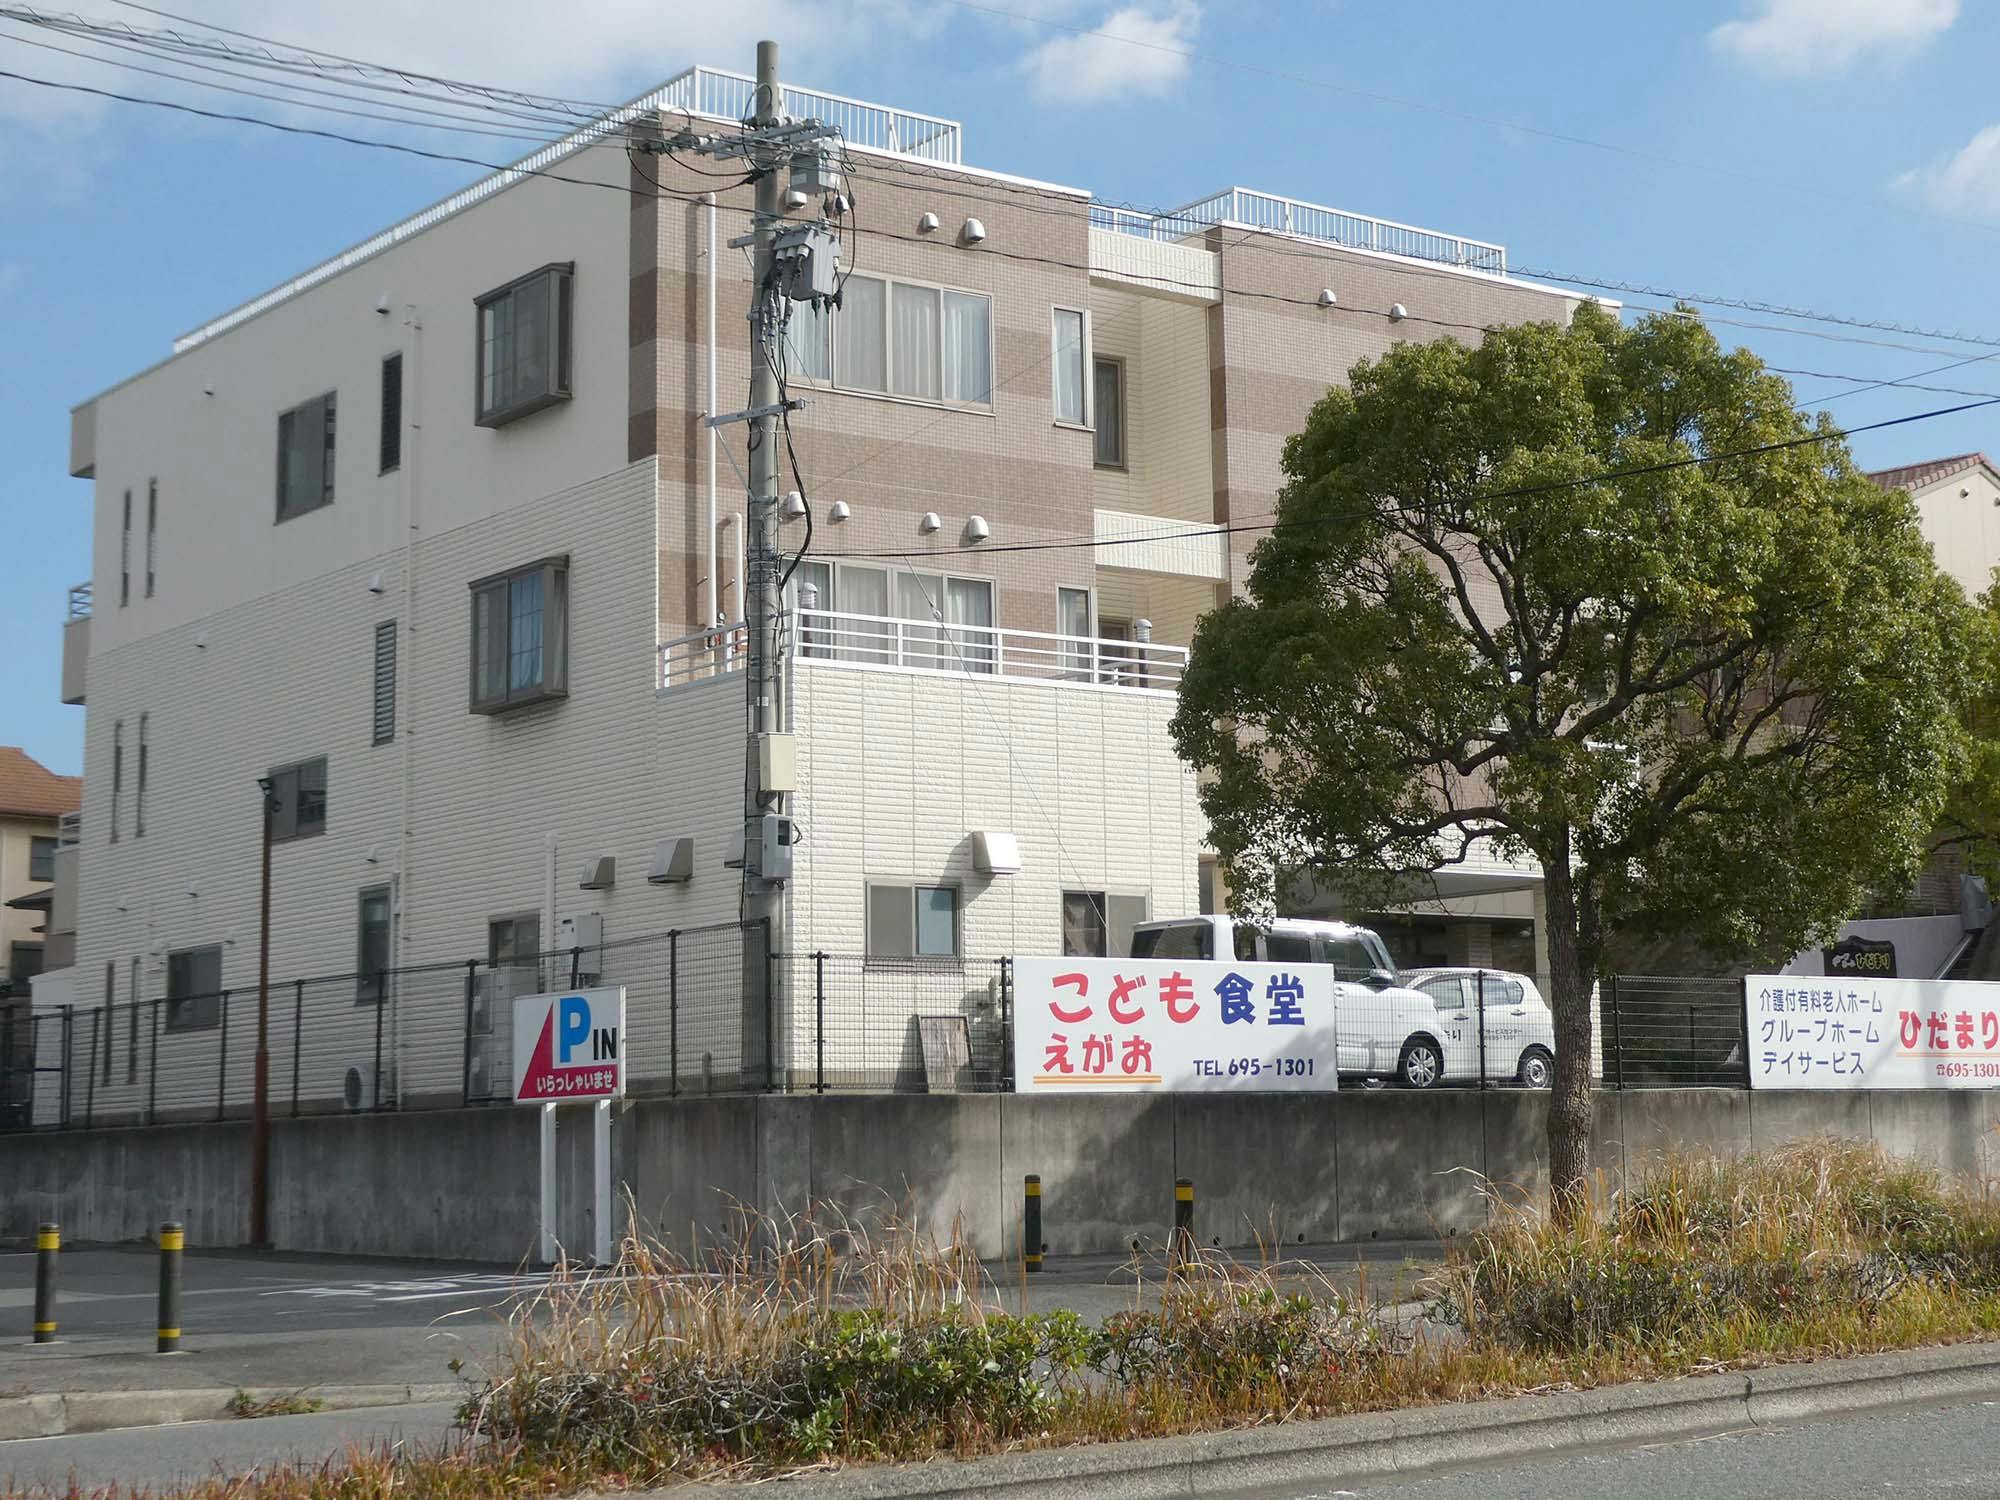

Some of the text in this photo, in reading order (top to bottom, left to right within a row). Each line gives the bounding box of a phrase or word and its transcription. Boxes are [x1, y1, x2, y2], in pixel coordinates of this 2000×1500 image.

[1048, 970, 1306, 1026] こども食堂
[1760, 988, 1883, 1013] 介護付有料老人ホーム
[559, 996, 617, 1064] P IN
[1761, 1019, 1880, 1043] グループホーム
[1899, 1010, 1999, 1050] ひだまり
[1042, 1033, 1153, 1075] えがお
[1763, 1051, 1865, 1075] デイサービス
[1229, 1058, 1315, 1077] 695-1301
[536, 1070, 613, 1093] いらっしゃいませ
